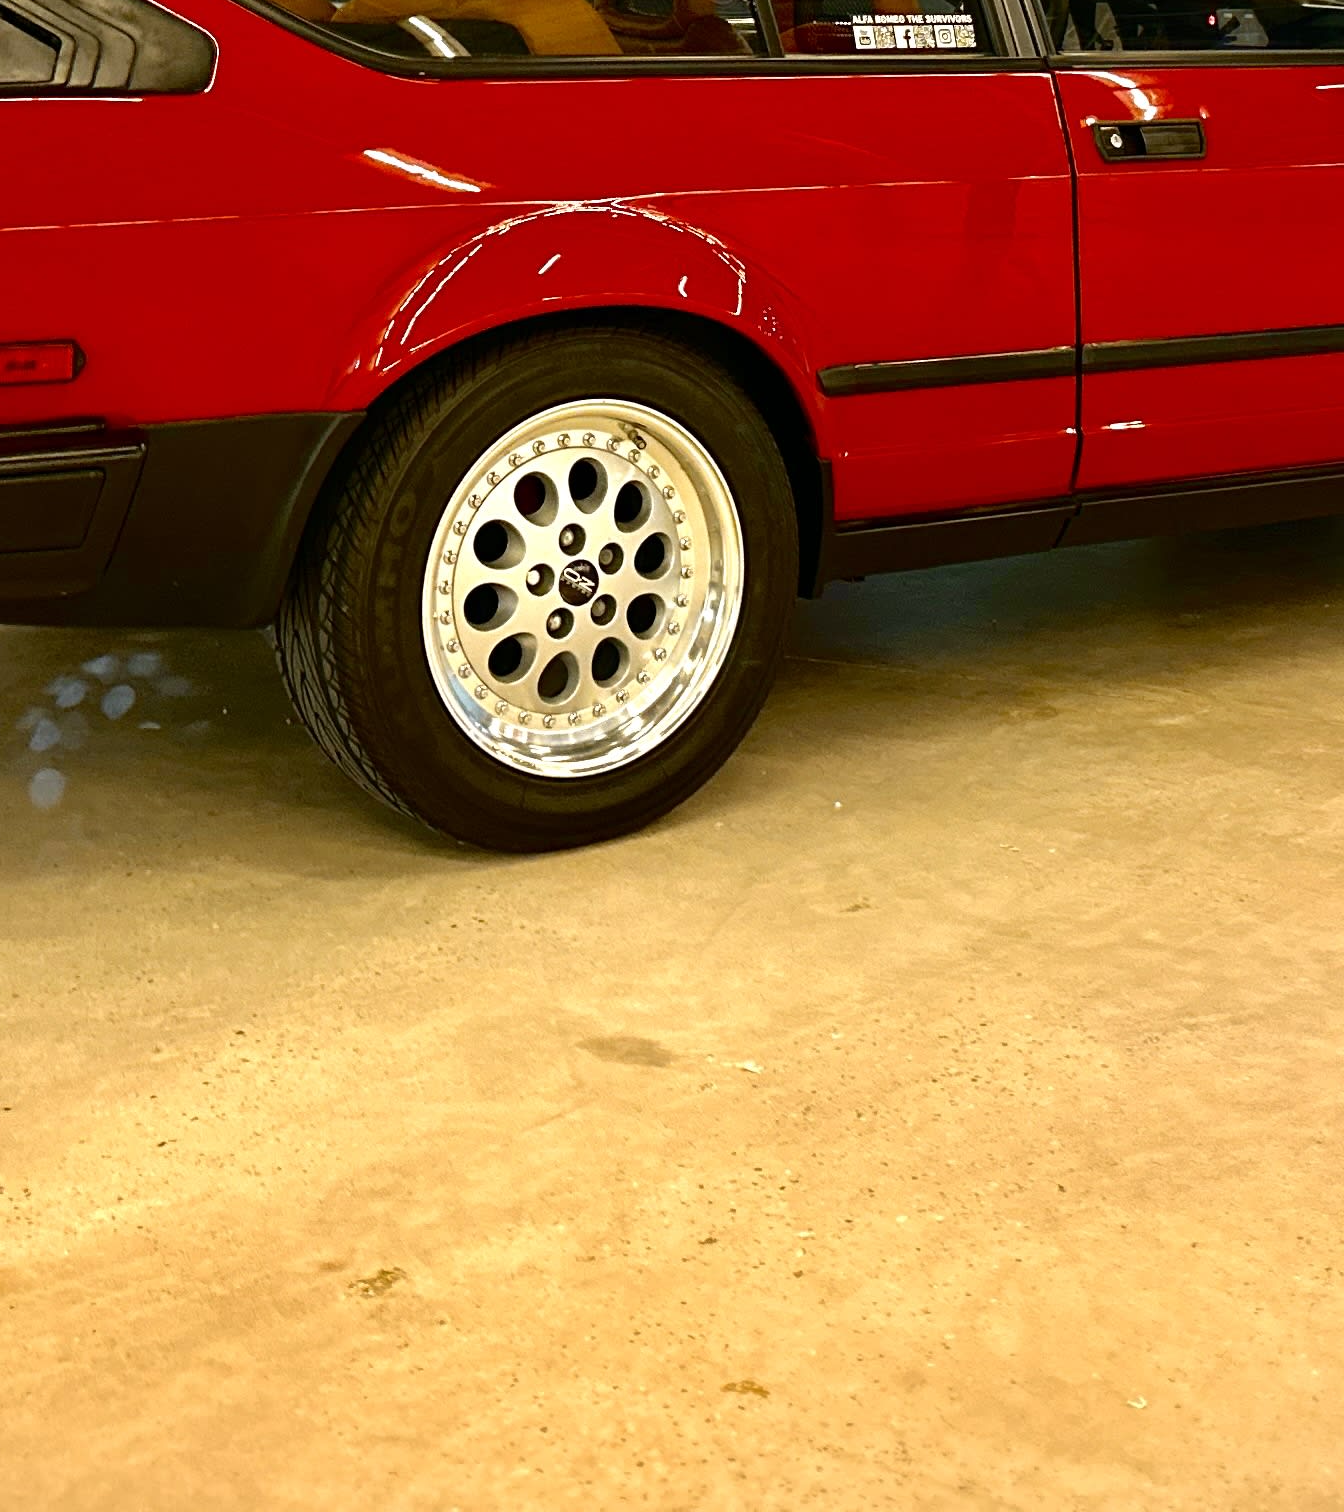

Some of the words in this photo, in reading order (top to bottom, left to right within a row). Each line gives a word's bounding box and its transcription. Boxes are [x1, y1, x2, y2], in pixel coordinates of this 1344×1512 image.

[852, 14, 874, 24] ALFA
[874, 14, 905, 24] ROMEO
[906, 14, 925, 24] THE
[925, 14, 973, 24] SURVIVORS
[563, 567, 596, 593] OZ
